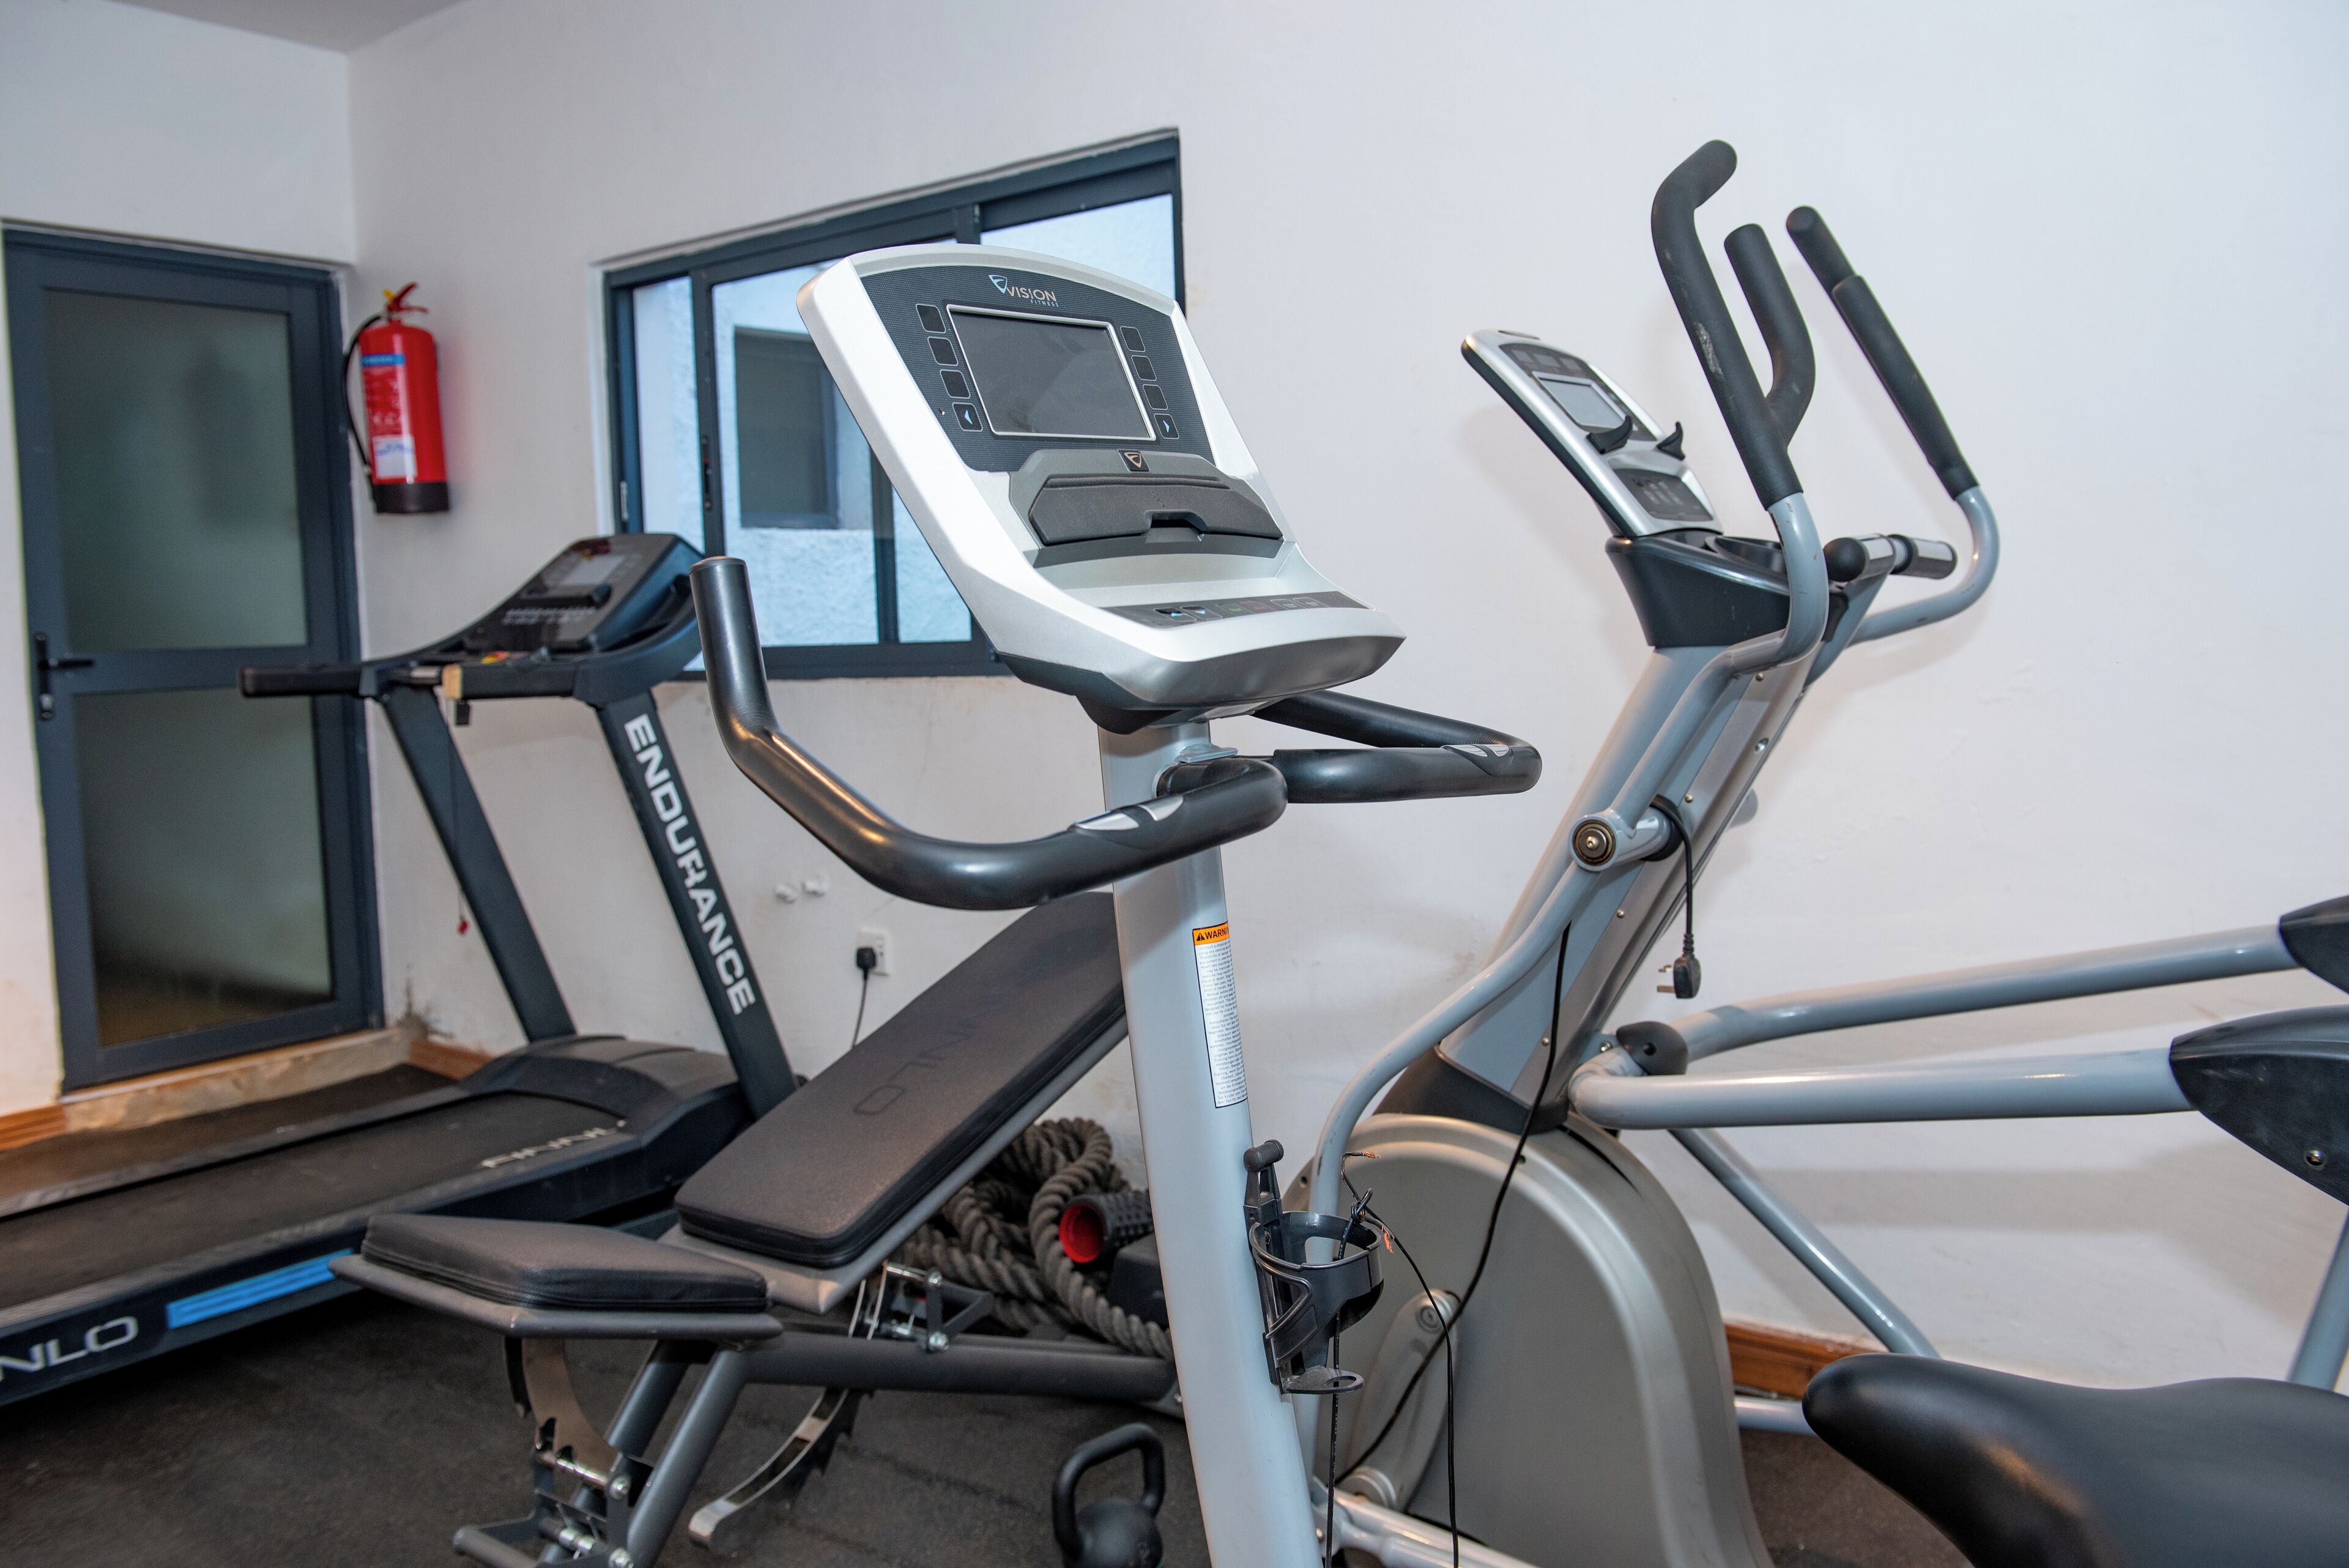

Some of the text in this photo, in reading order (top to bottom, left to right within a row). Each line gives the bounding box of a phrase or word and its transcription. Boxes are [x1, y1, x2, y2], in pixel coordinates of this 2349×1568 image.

[1006, 286, 1057, 302] VISION
[624, 713, 755, 1015] ENDURANCE
[1205, 927, 1228, 939] WARN
